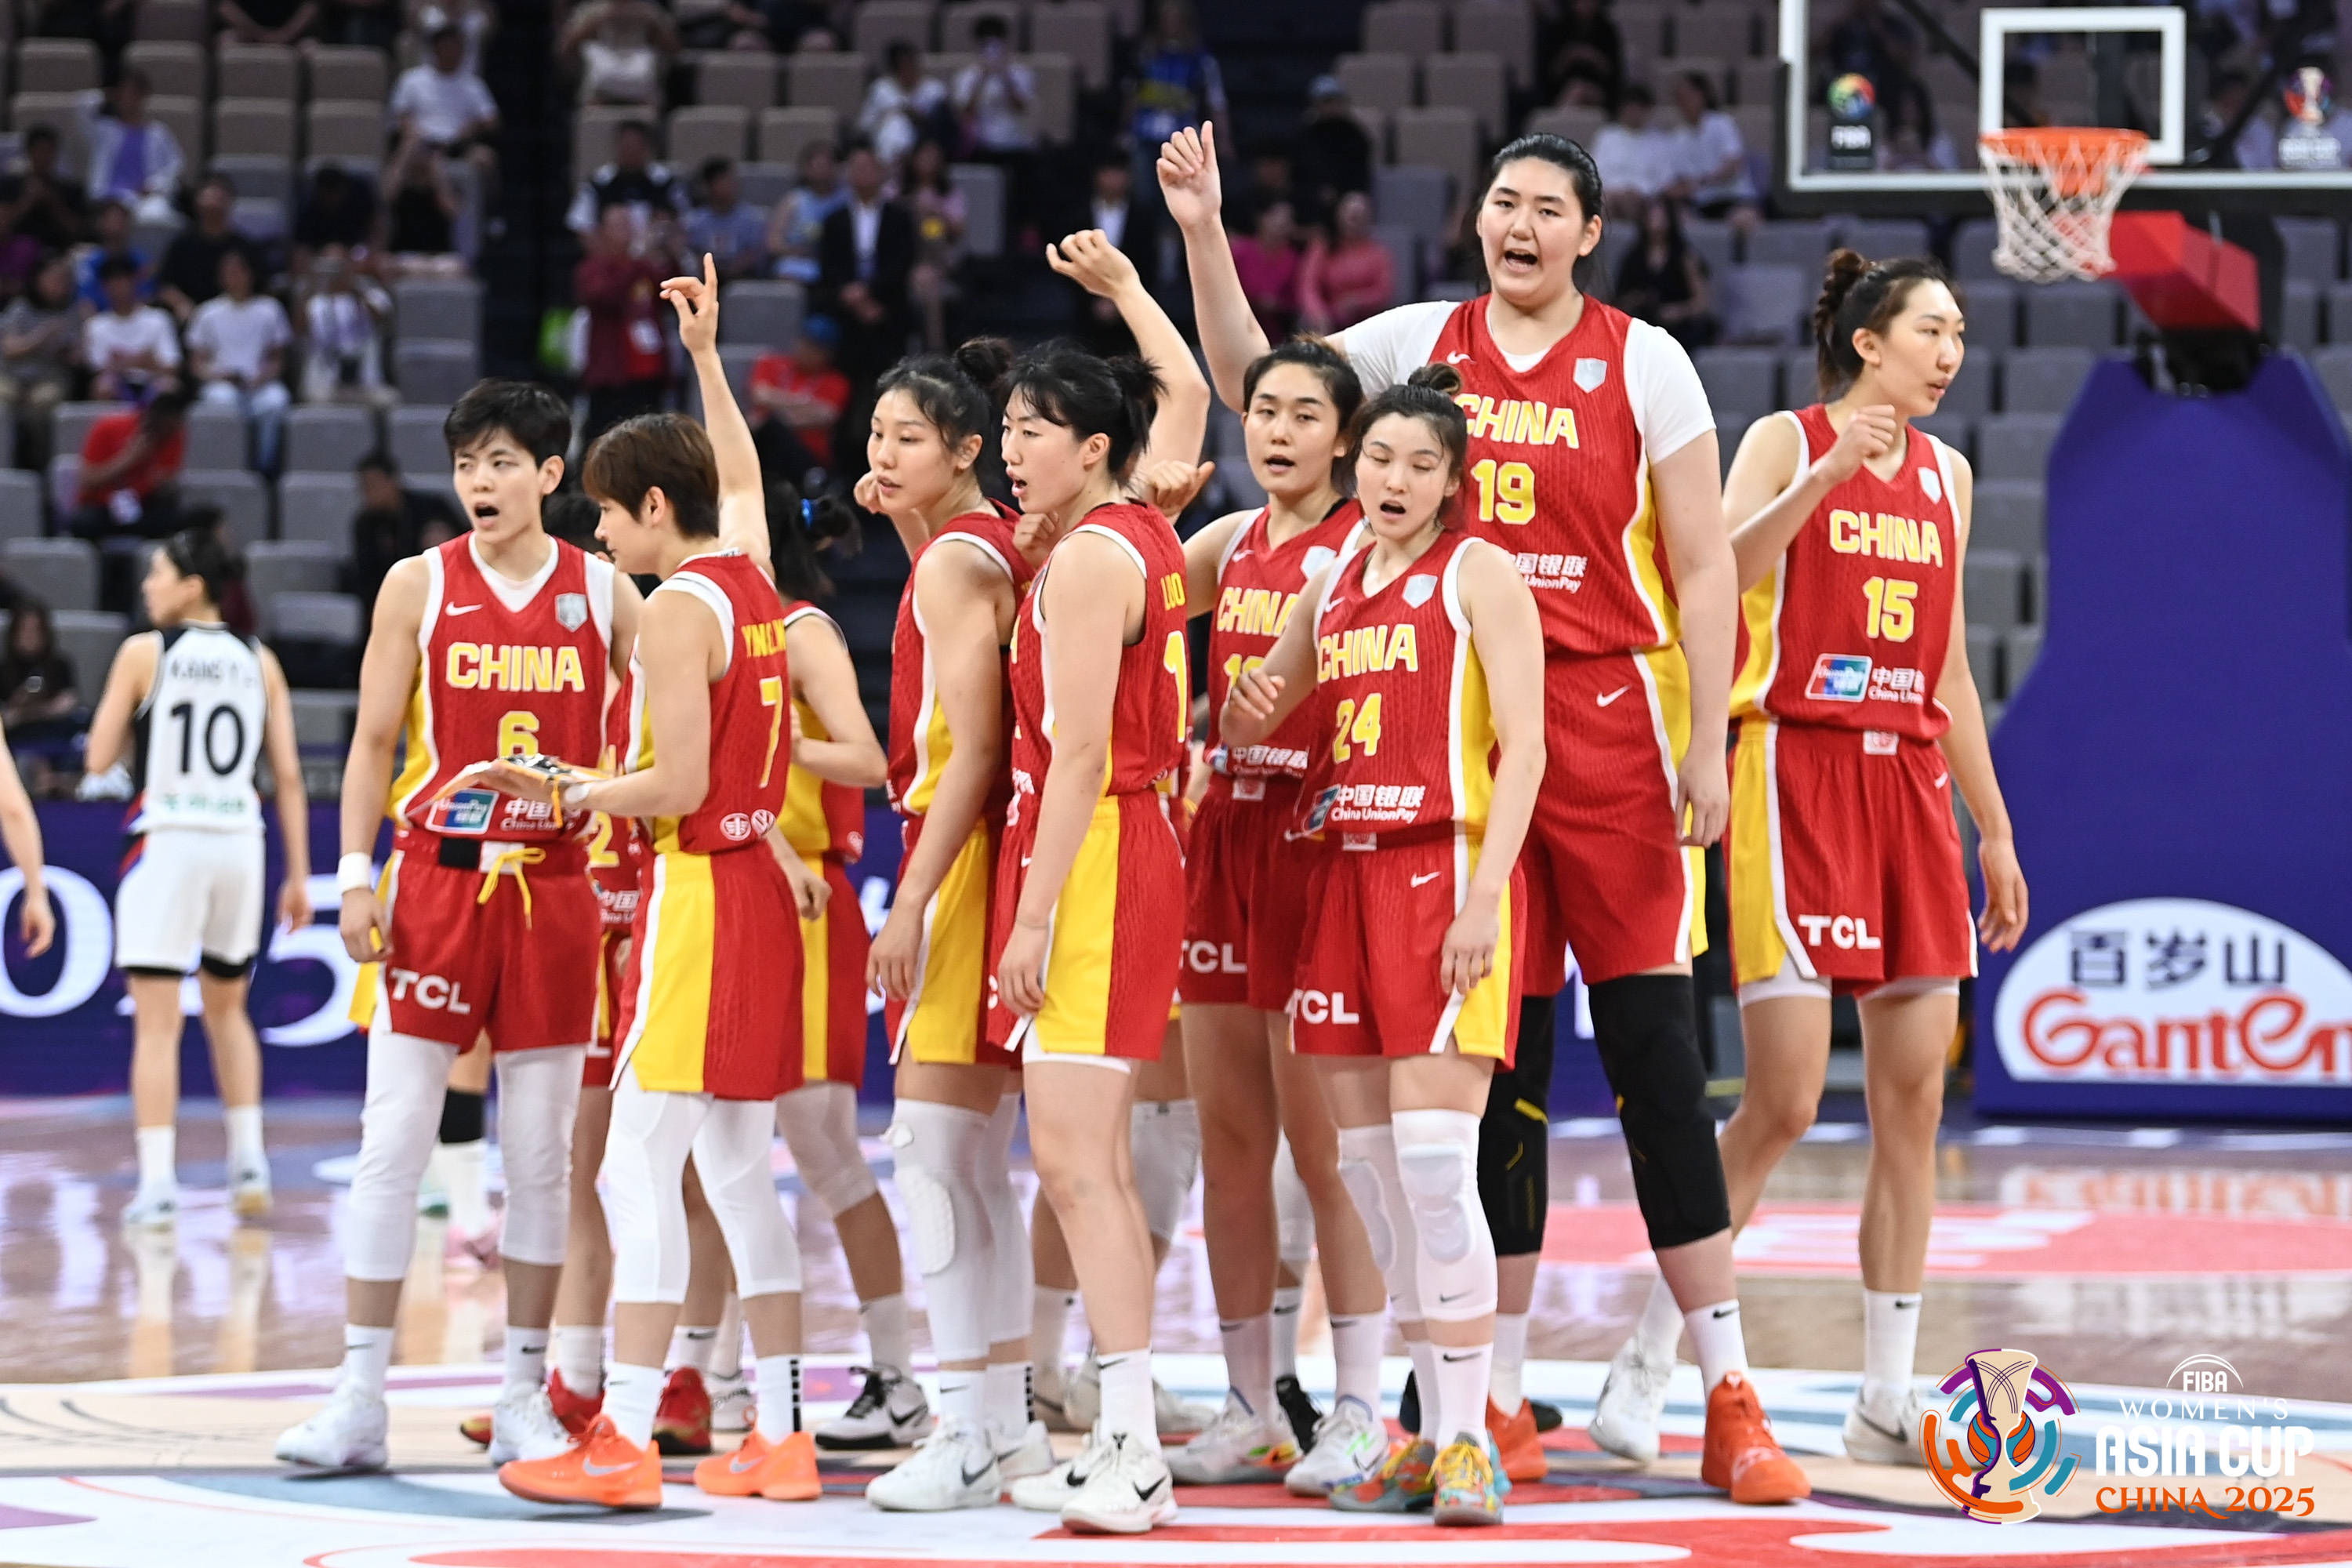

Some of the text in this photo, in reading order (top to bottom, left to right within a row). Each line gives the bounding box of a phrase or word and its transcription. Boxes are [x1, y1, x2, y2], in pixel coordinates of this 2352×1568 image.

[1454, 393, 1580, 449] CHINA
[1471, 459, 1536, 524] 19
[1510, 552, 1588, 578] 国银联
[1830, 509, 1944, 568] CHINA
[1160, 572, 1185, 611] LUO
[1862, 576, 1918, 643] 15
[446, 641, 586, 692] CHINA
[1317, 623, 1419, 684] CHINA
[171, 702, 245, 775] 10
[498, 710, 540, 759] 6
[759, 675, 783, 789] 7
[1334, 692, 1382, 764] 24
[1331, 806, 1360, 821] China
[1362, 808, 1418, 824] UnionPay
[1335, 784, 1426, 808] 中国银联
[1798, 914, 1882, 949] TCL
[2071, 928, 2287, 991] 百岁山
[389, 967, 471, 1015] TCL
